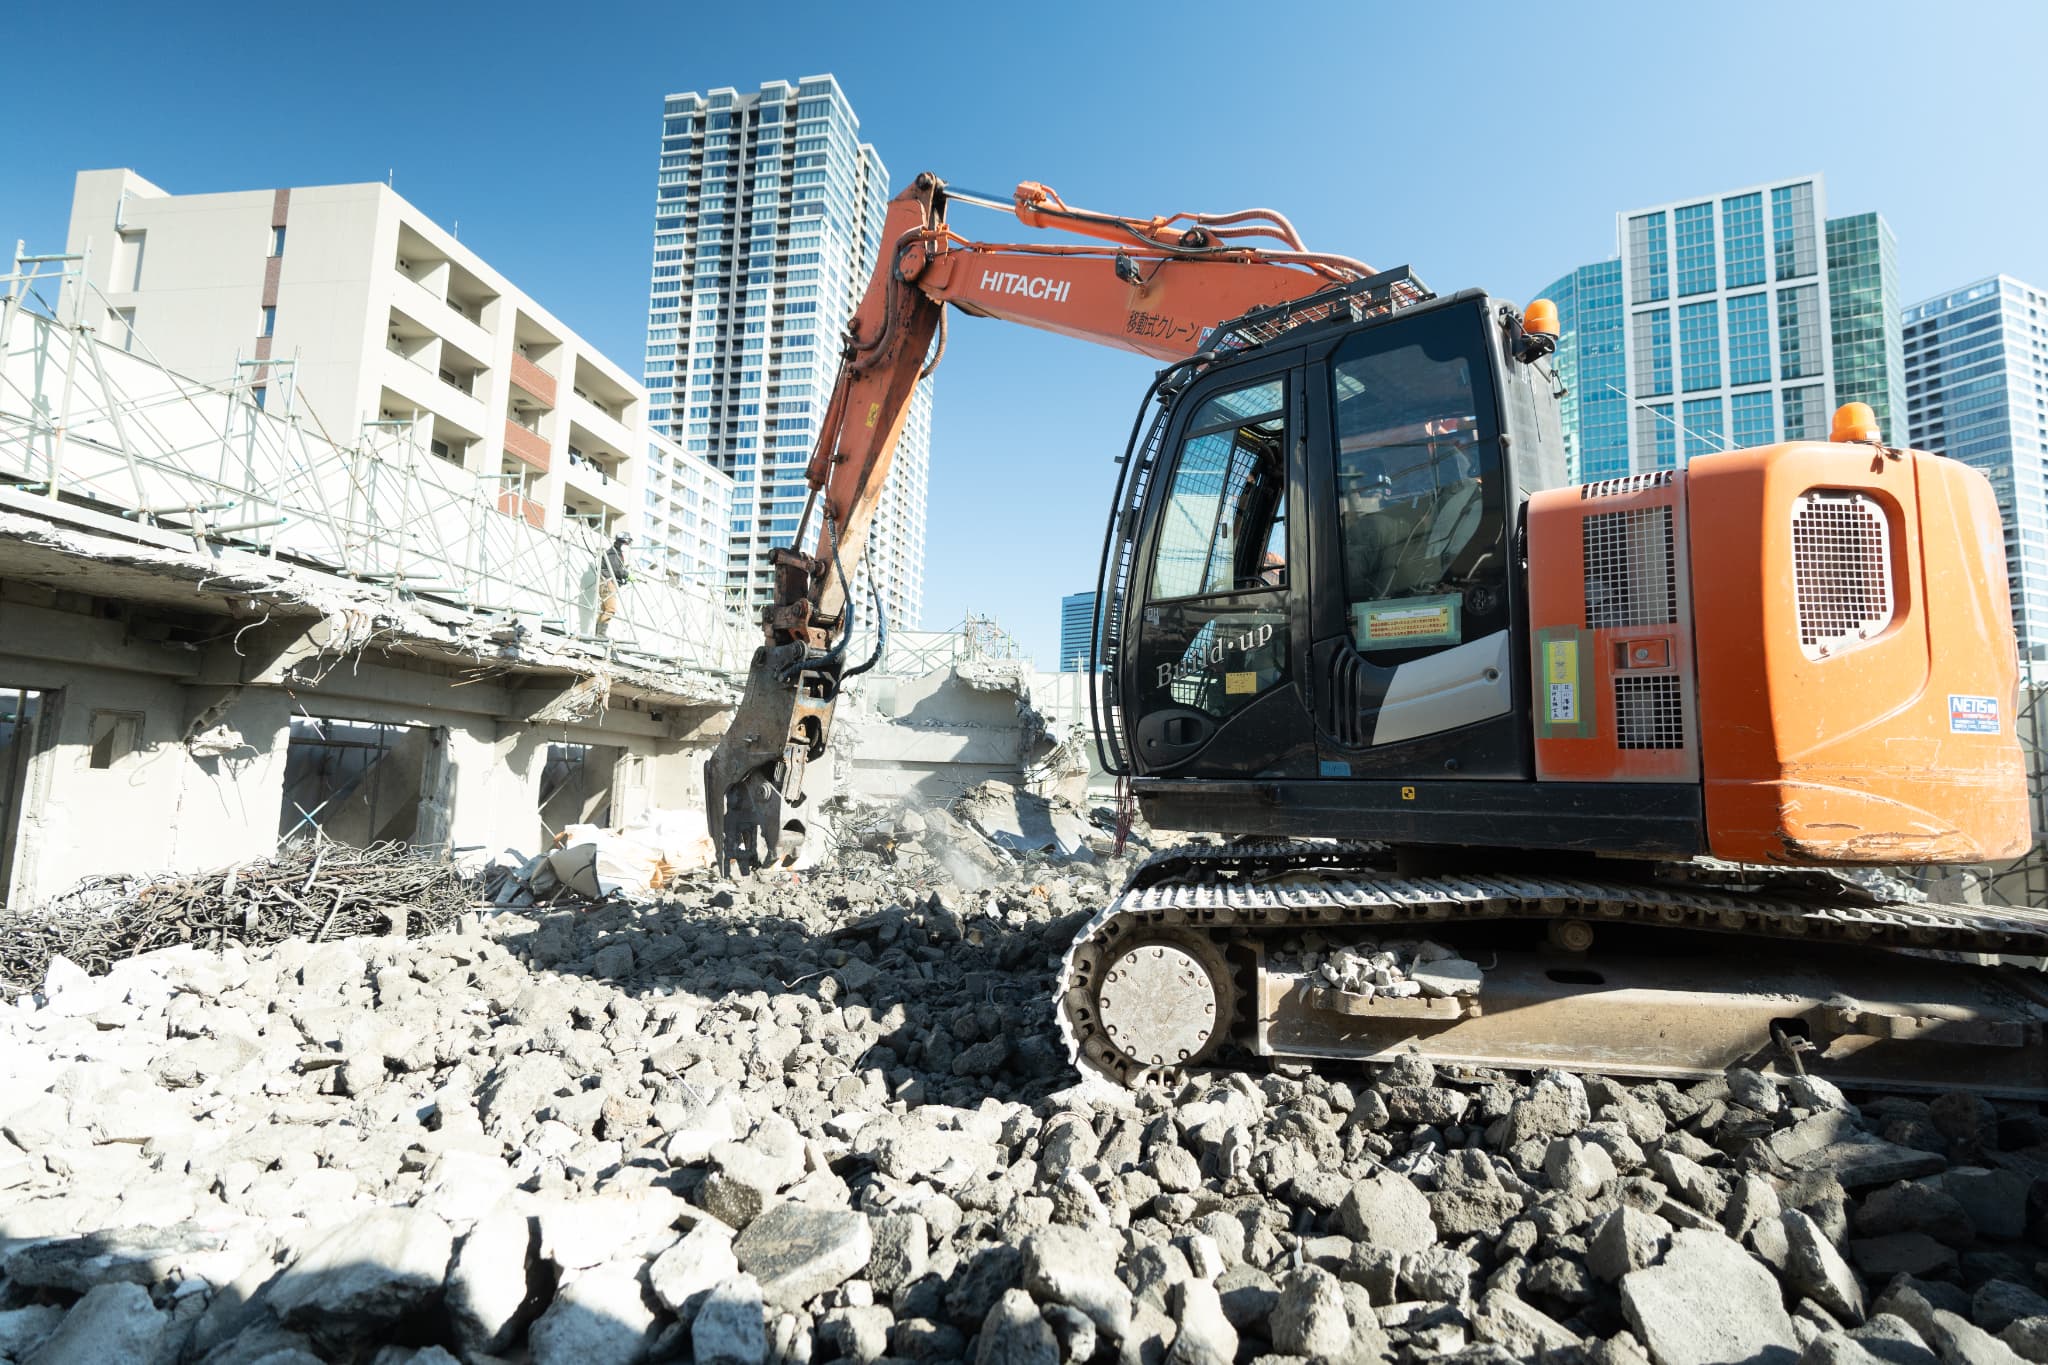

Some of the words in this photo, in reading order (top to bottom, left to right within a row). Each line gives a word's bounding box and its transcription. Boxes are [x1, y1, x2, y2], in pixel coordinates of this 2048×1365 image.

[979, 269, 1071, 303] HITACHI
[1126, 310, 1200, 342] 移動式クレーン
